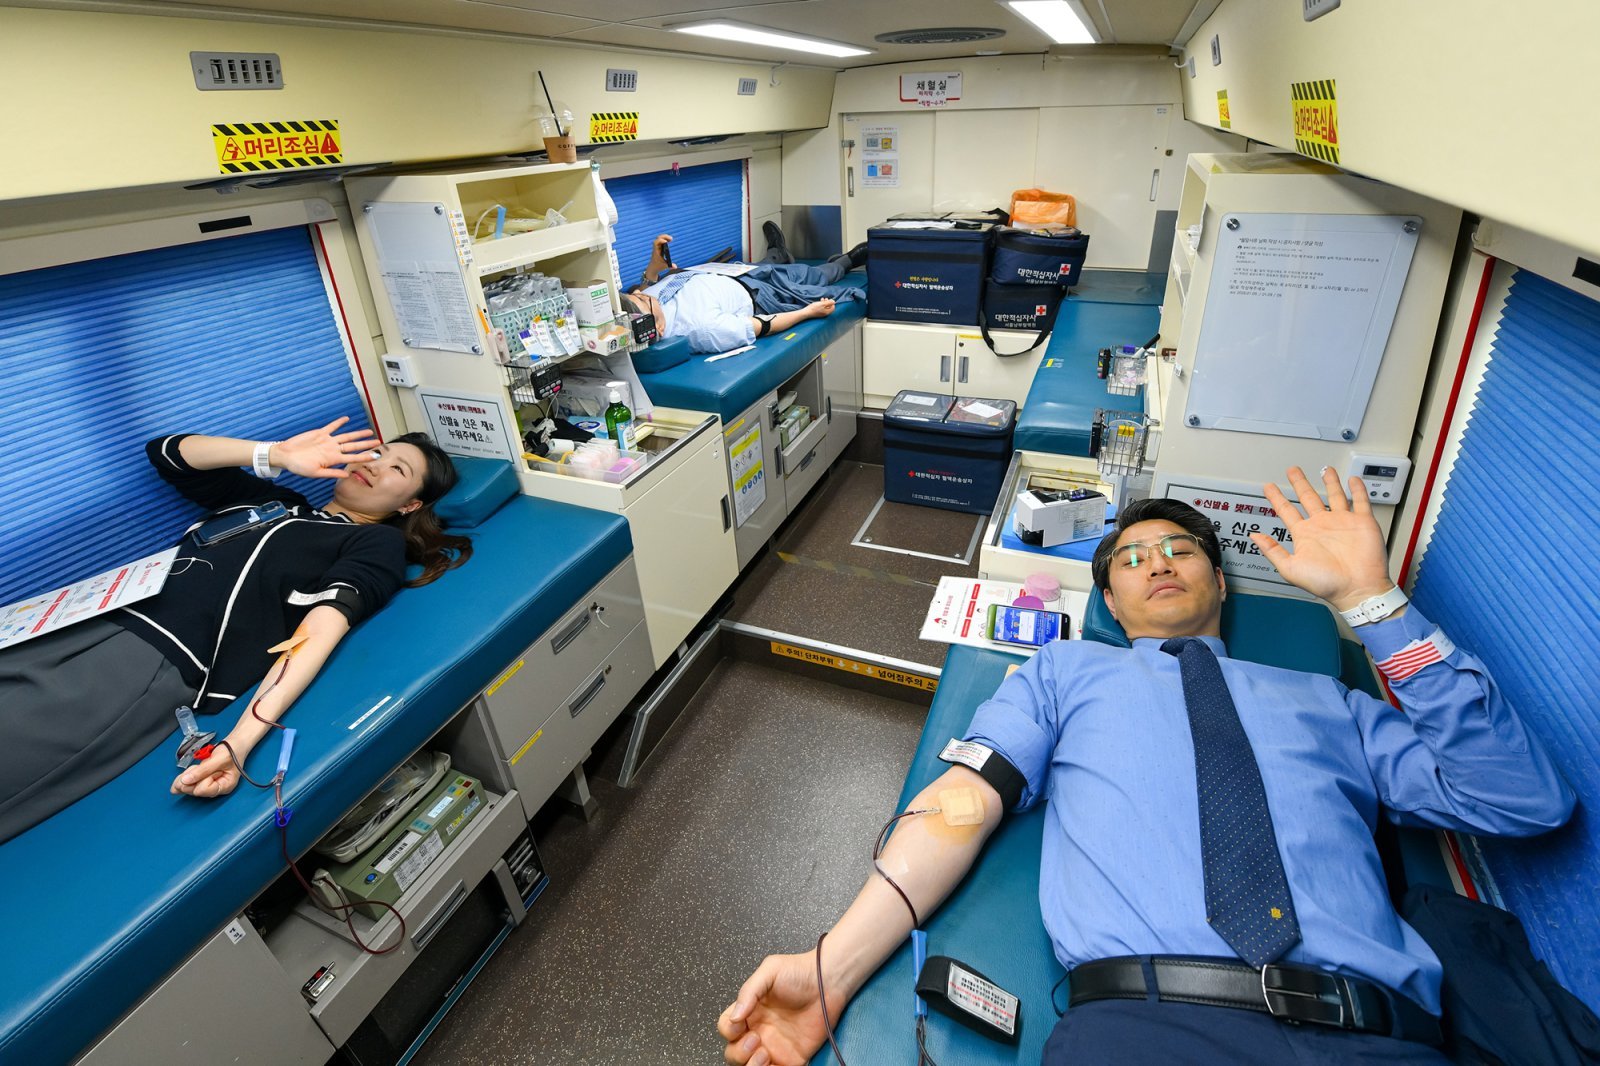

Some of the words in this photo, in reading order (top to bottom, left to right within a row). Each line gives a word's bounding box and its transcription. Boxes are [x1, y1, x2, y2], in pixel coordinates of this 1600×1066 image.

[917, 80, 947, 91] 채혈실
[601, 121, 630, 134] 머리조심
[1300, 106, 1328, 140] 머리조심
[244, 135, 319, 158] 머리조심
[1017, 268, 1060, 281] 대한적십자사
[902, 282, 928, 290] 대한적십자사
[995, 313, 1037, 322] 대한적십자사
[439, 415, 460, 428] 신발을
[462, 418, 478, 430] 신은
[448, 428, 485, 443] 누워주세요
[1203, 500, 1230, 512] 신발을
[1234, 503, 1254, 513] 벗지
[1259, 506, 1280, 518] 마세
[1232, 521, 1261, 537] 신은
[1220, 537, 1261, 554] 주세요
[1225, 560, 1244, 568] your
[1247, 562, 1270, 572] shoes
[786, 647, 803, 658] 주의!
